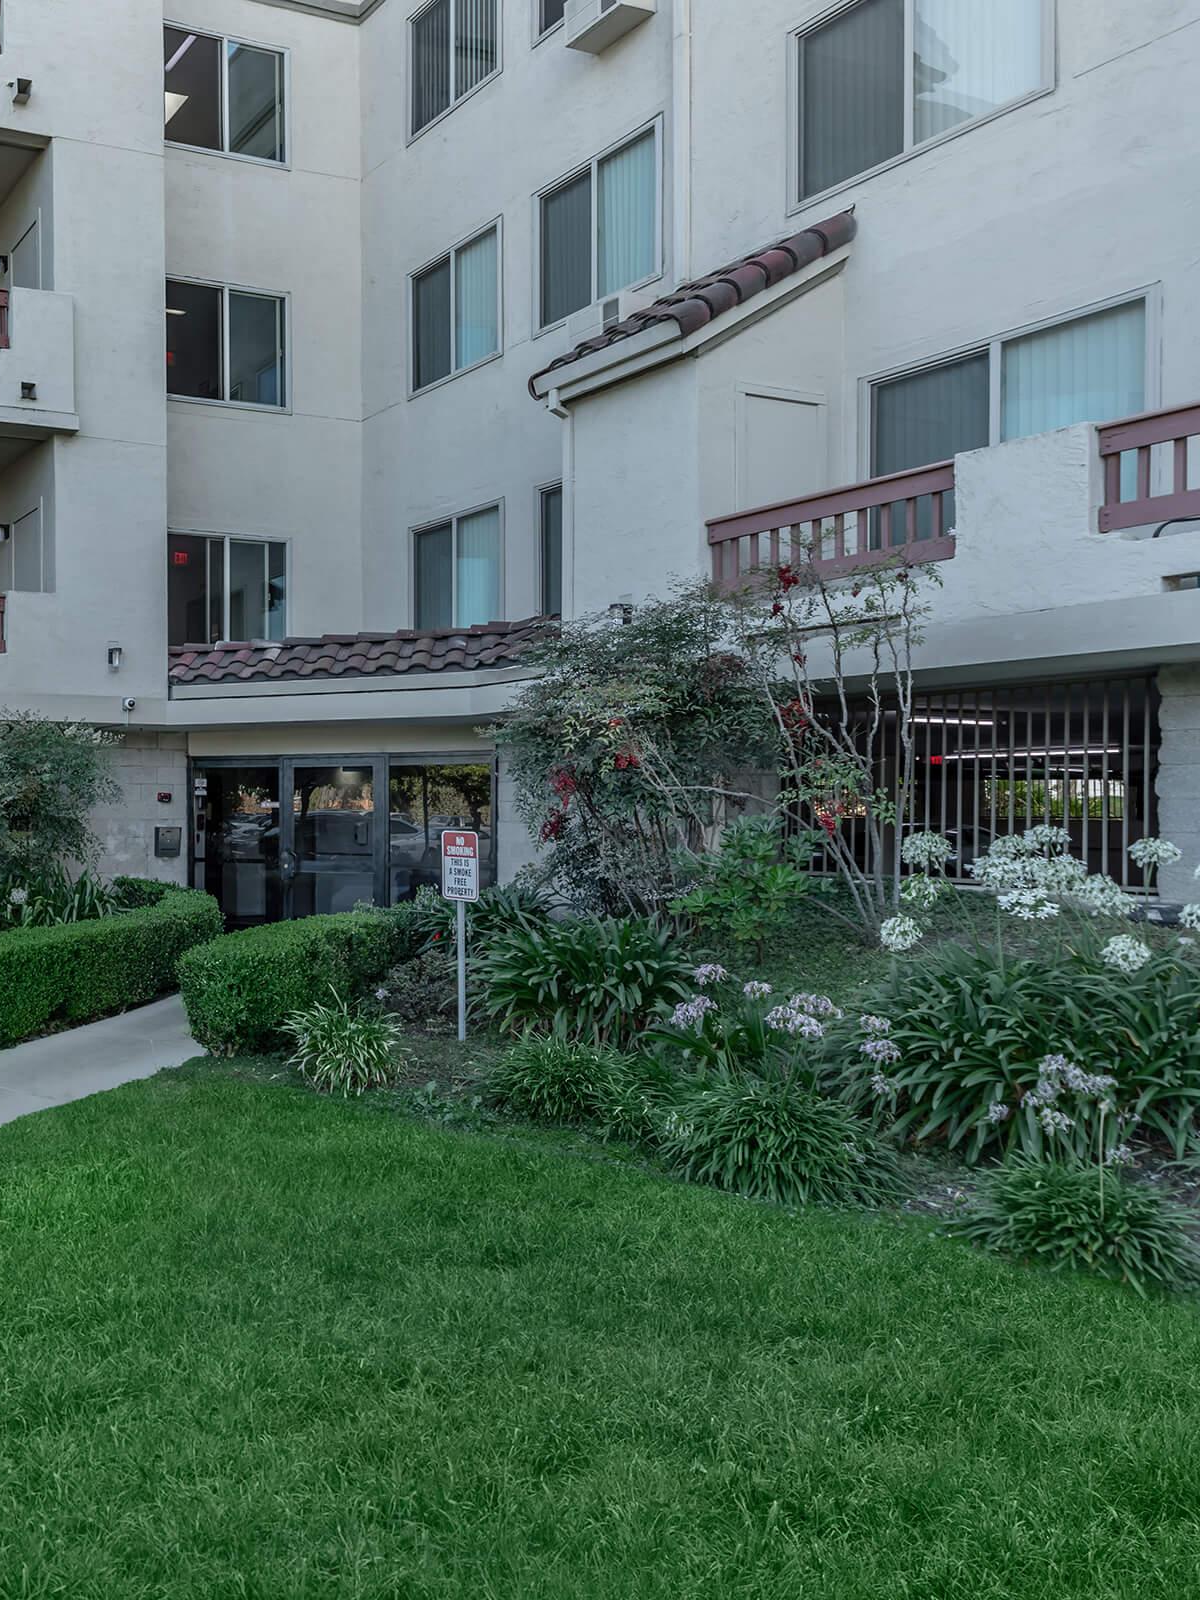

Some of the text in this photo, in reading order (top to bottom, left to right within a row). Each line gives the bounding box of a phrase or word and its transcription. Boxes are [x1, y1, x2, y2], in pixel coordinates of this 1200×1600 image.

[456, 836, 465, 846] NO
[447, 846, 474, 856] SMOKING
[451, 858, 470, 867] THIS IS
[454, 868, 472, 877] SMOKE
[454, 877, 467, 886] FREE
[447, 887, 474, 897] PROPERTY
